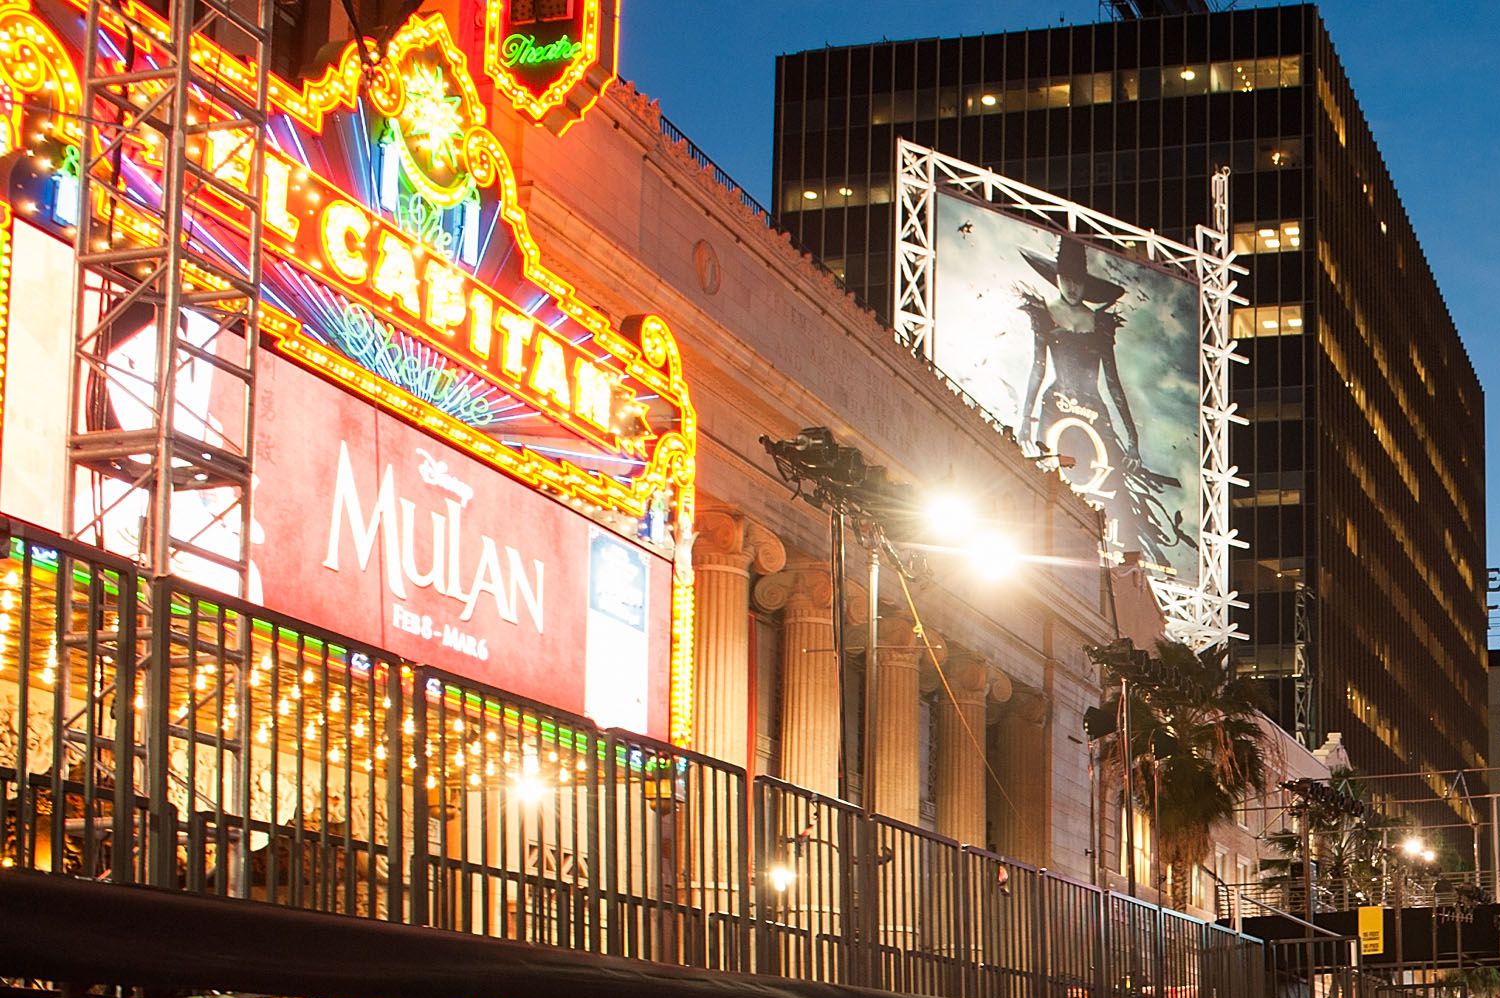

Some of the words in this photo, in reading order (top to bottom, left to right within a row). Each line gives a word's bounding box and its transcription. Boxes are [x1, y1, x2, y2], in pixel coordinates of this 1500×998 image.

[500, 33, 582, 68] Theatre
[320, 199, 612, 433] CAPITAN
[343, 302, 494, 426] Theatre
[322, 438, 545, 635] MULAN
